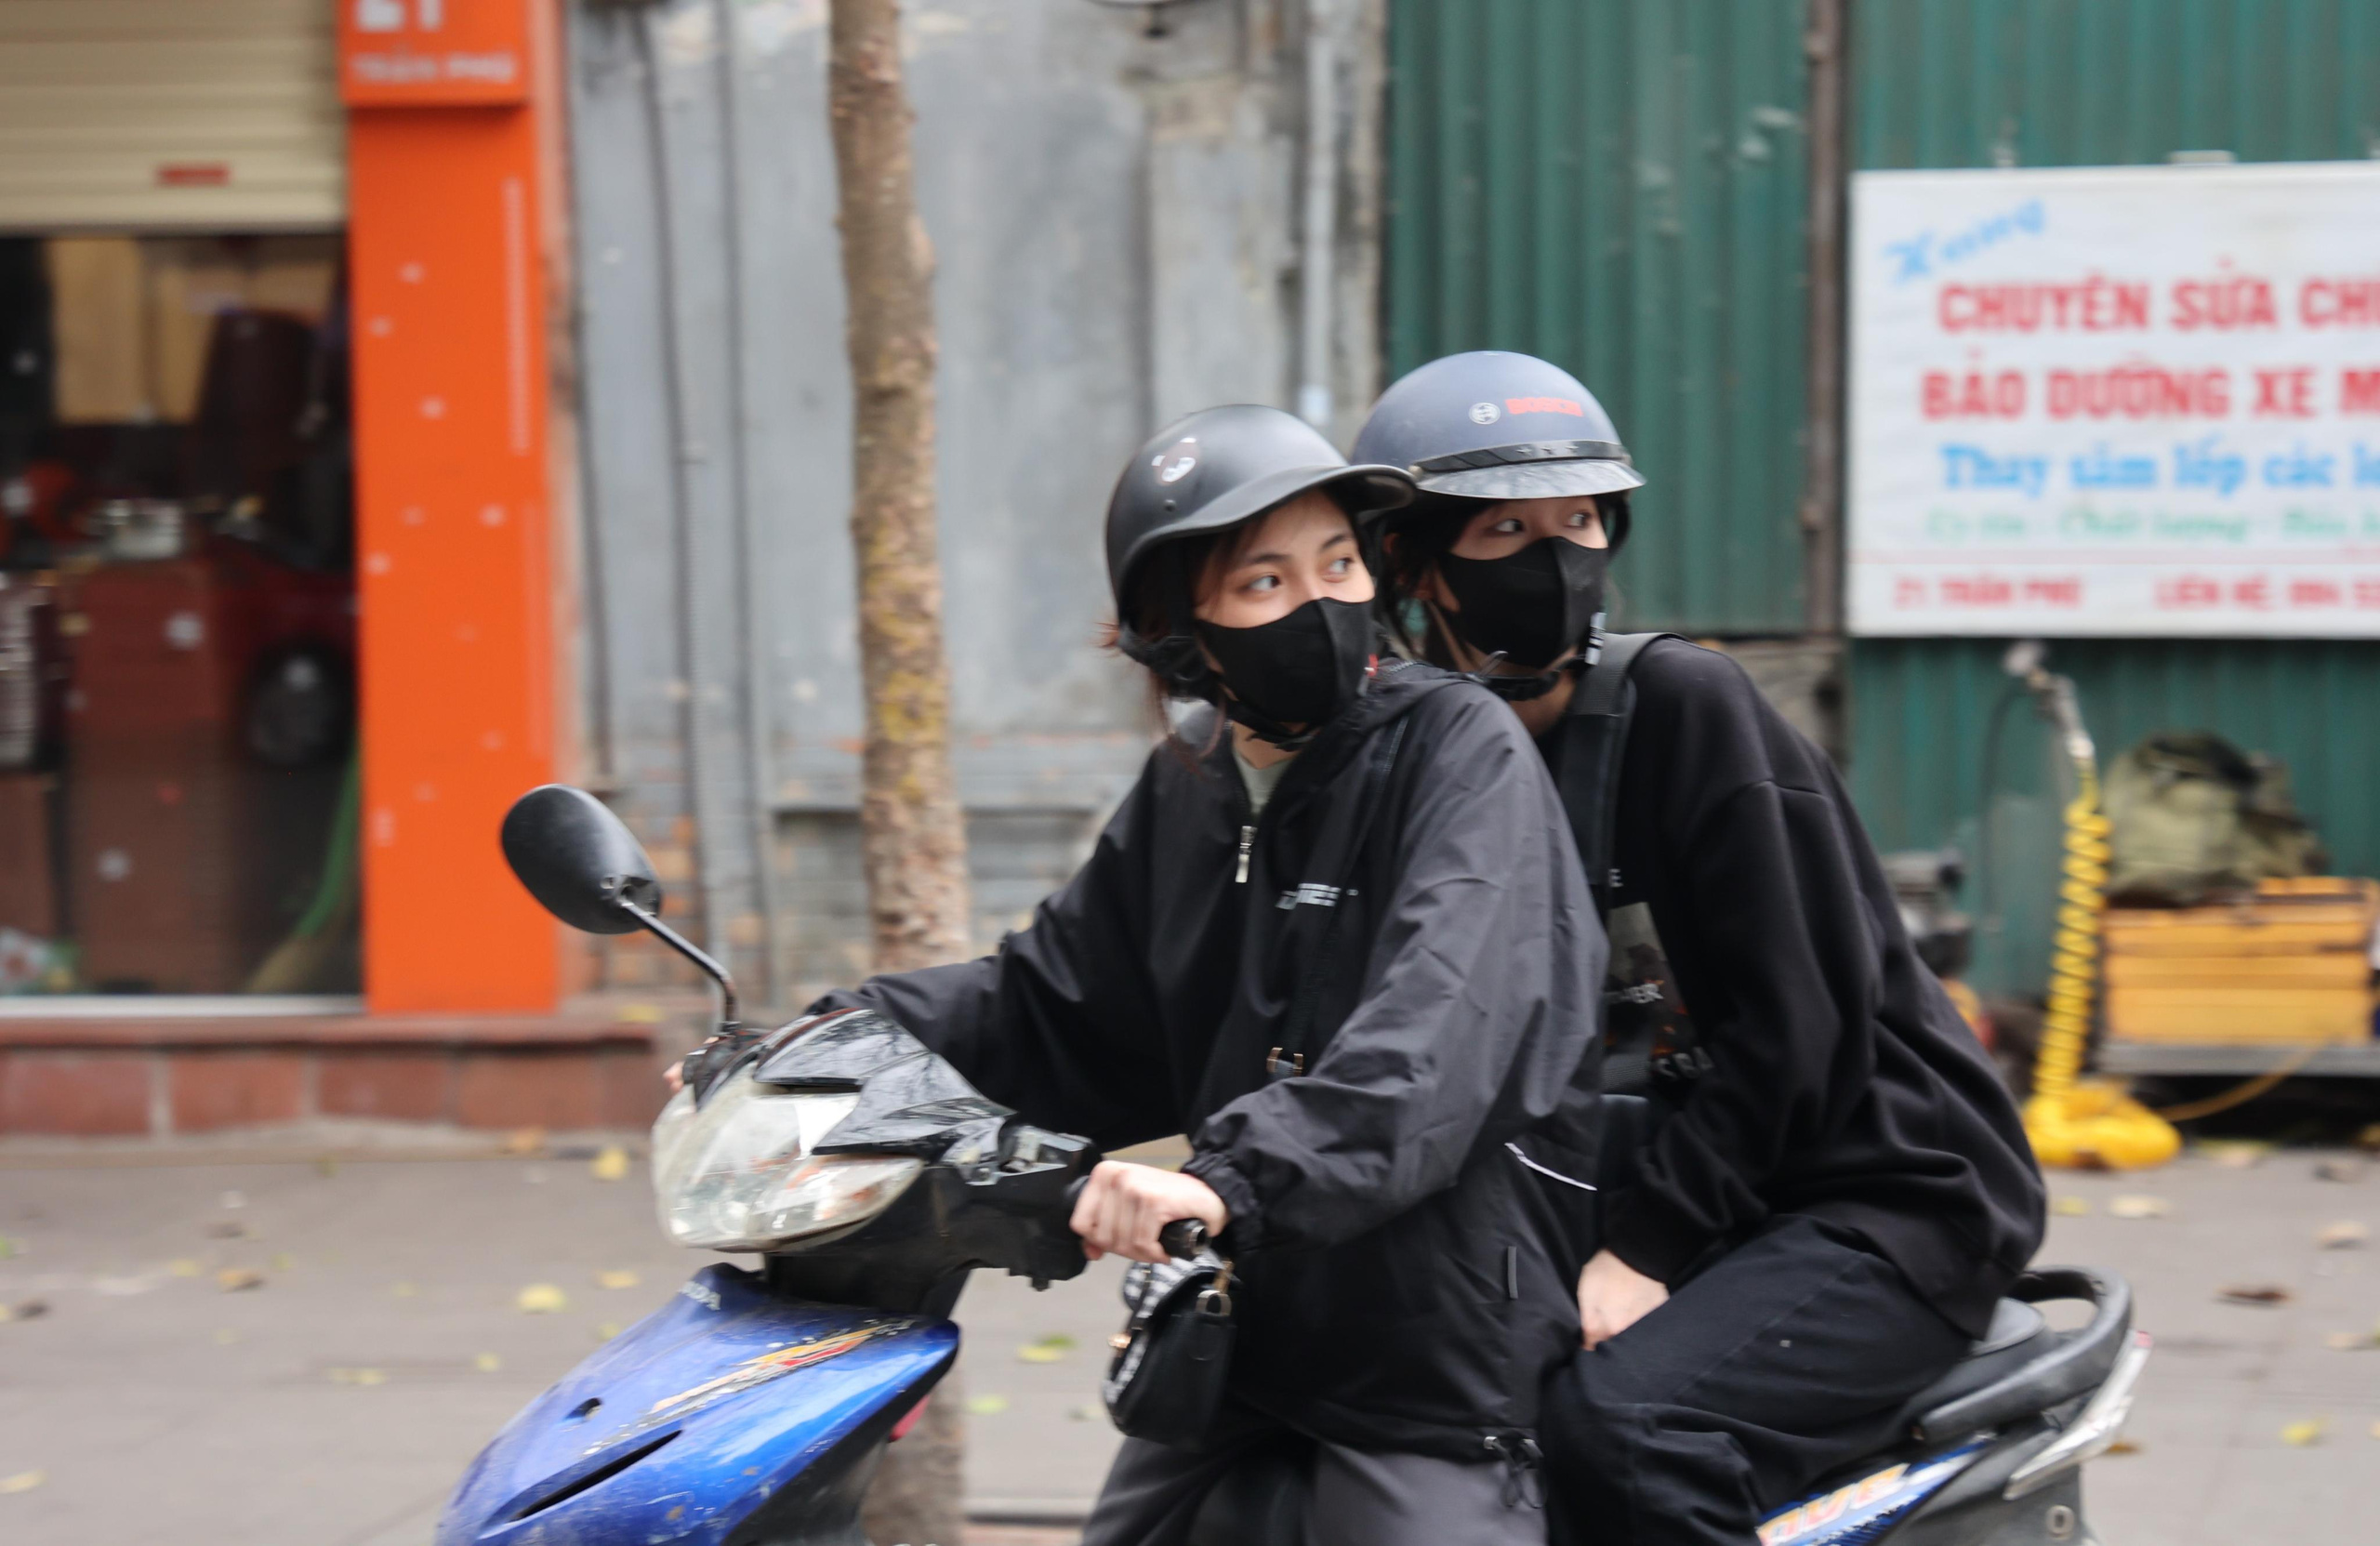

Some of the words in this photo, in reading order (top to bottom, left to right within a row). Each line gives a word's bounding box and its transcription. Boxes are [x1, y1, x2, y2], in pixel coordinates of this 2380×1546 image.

[1922, 347, 2027, 420] BẢO
[2253, 366, 2315, 418] XE
[1938, 443, 2049, 498] Thay
